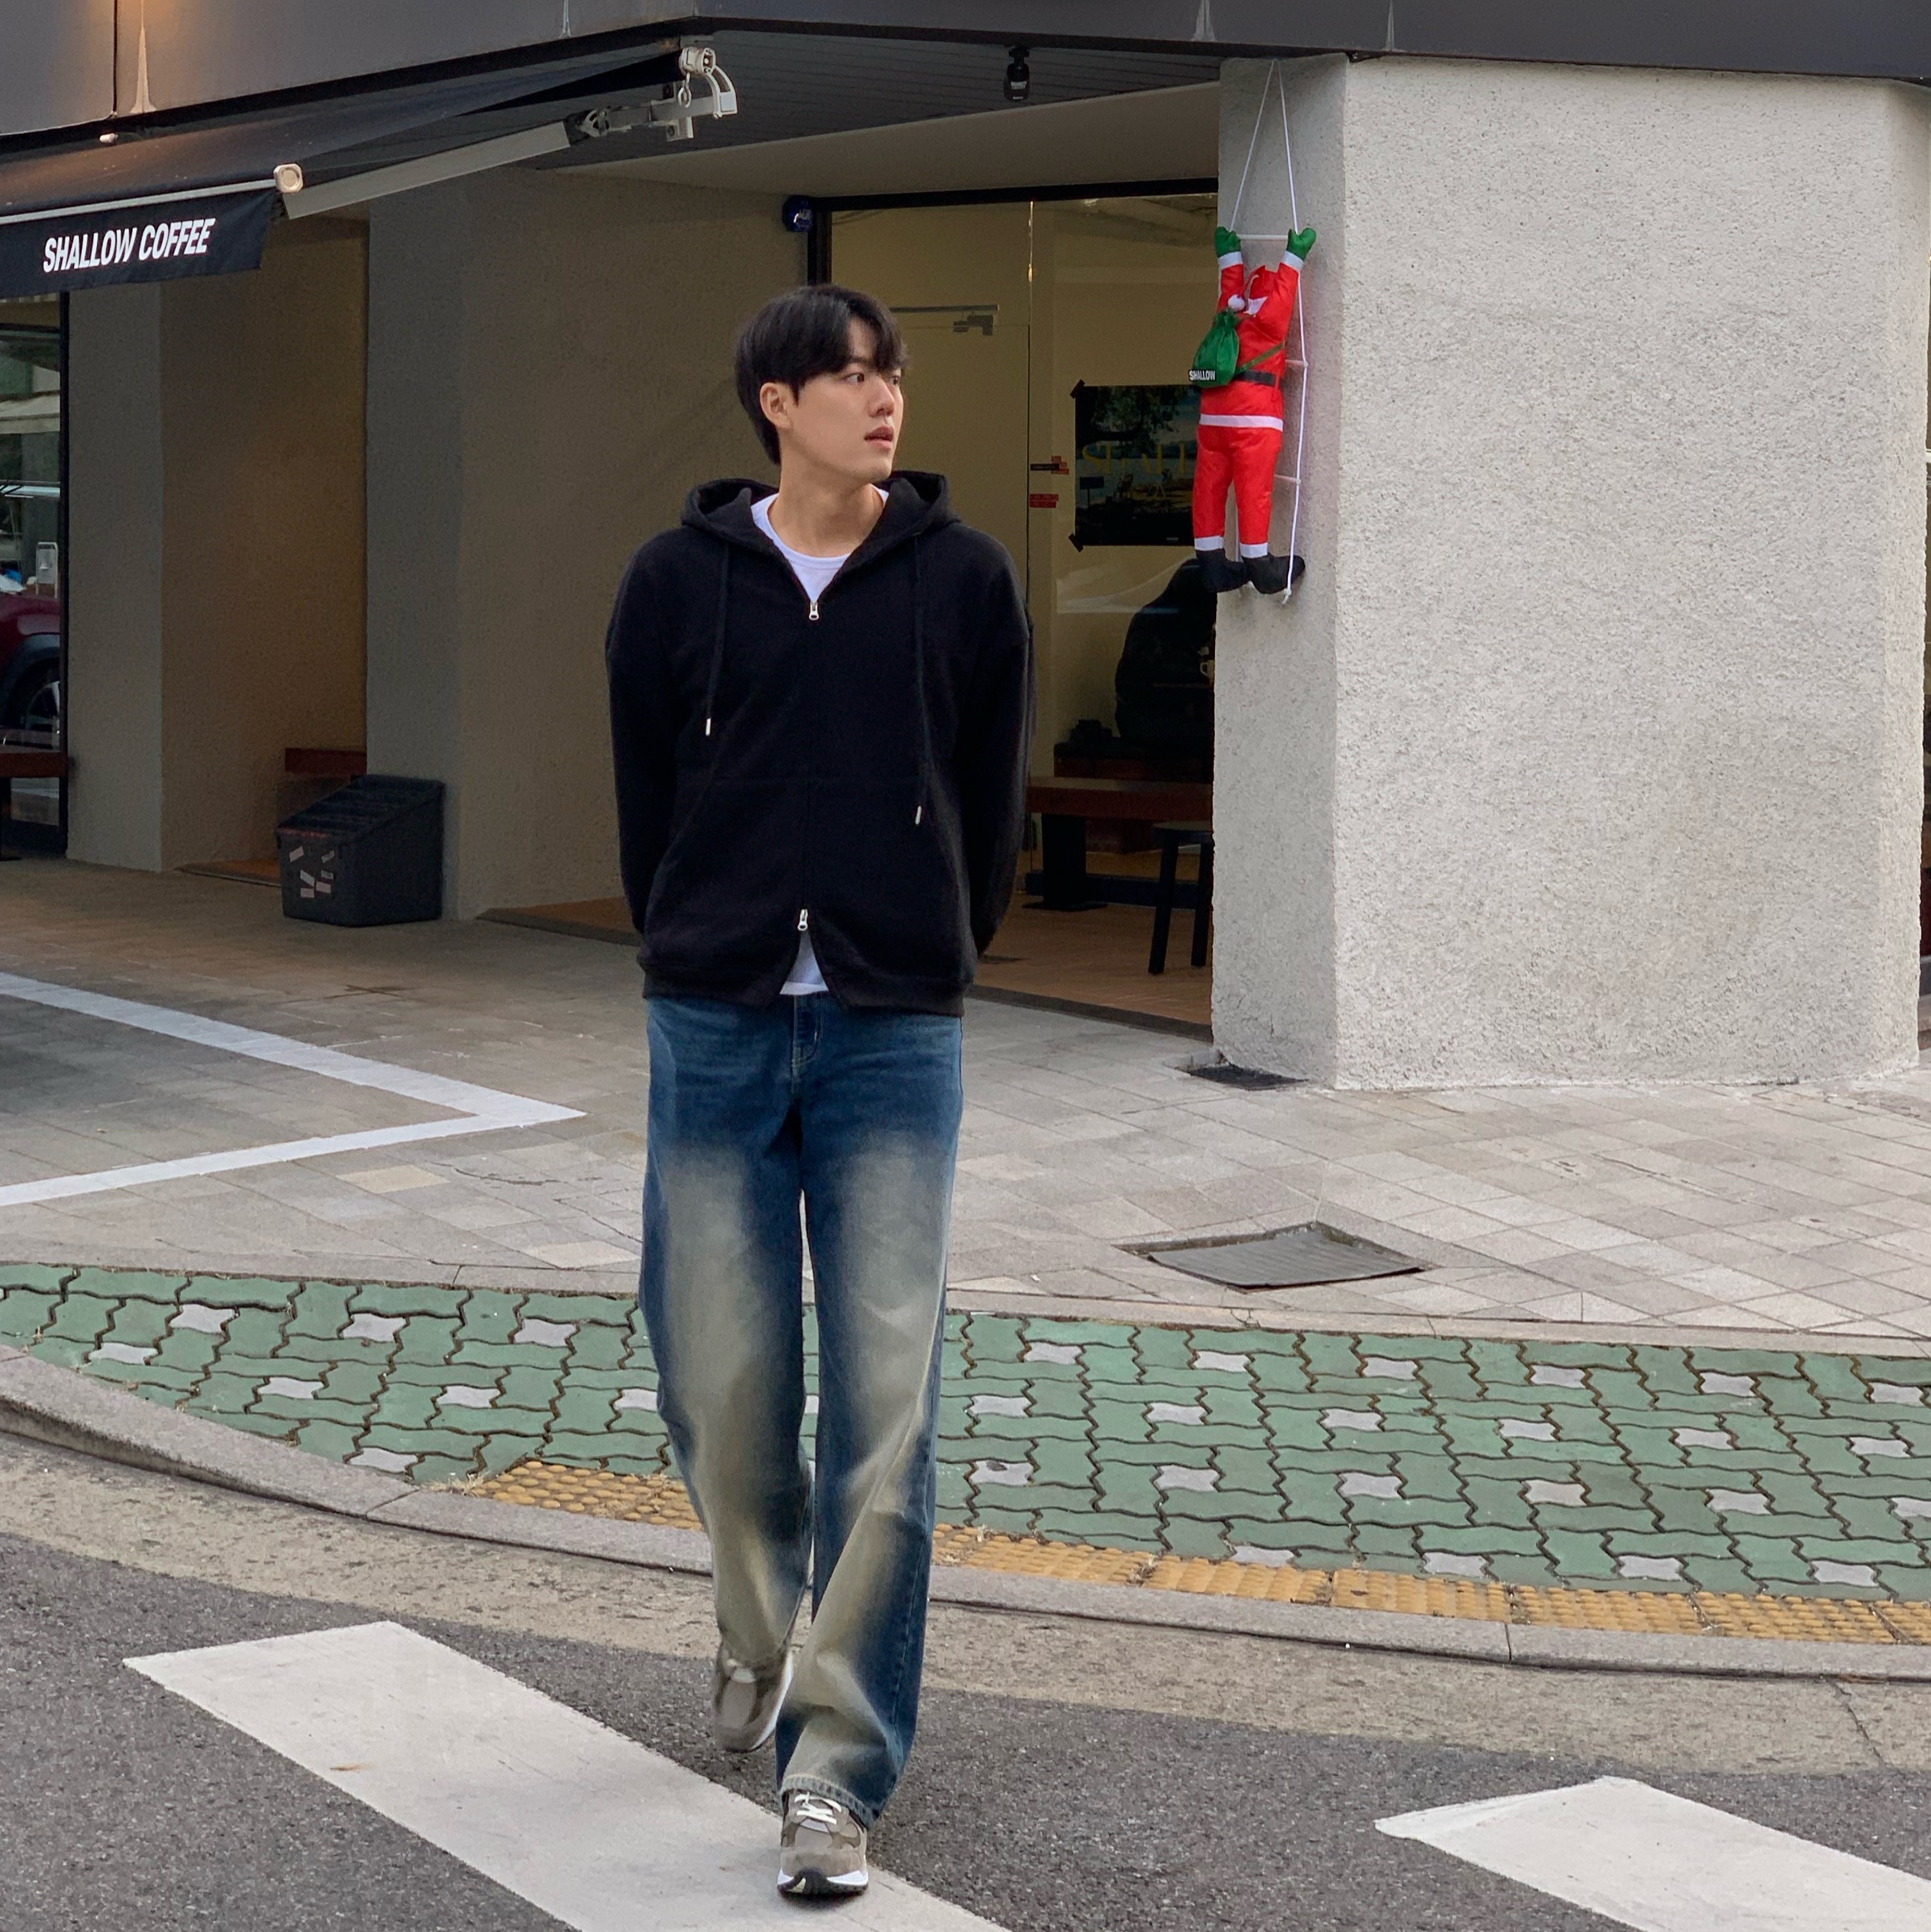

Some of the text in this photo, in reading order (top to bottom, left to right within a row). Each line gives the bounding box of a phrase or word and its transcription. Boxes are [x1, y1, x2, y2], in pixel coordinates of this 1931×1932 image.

[43, 218, 216, 273] SHALLOW COFFEE
[1189, 370, 1216, 381] SHALLOW
